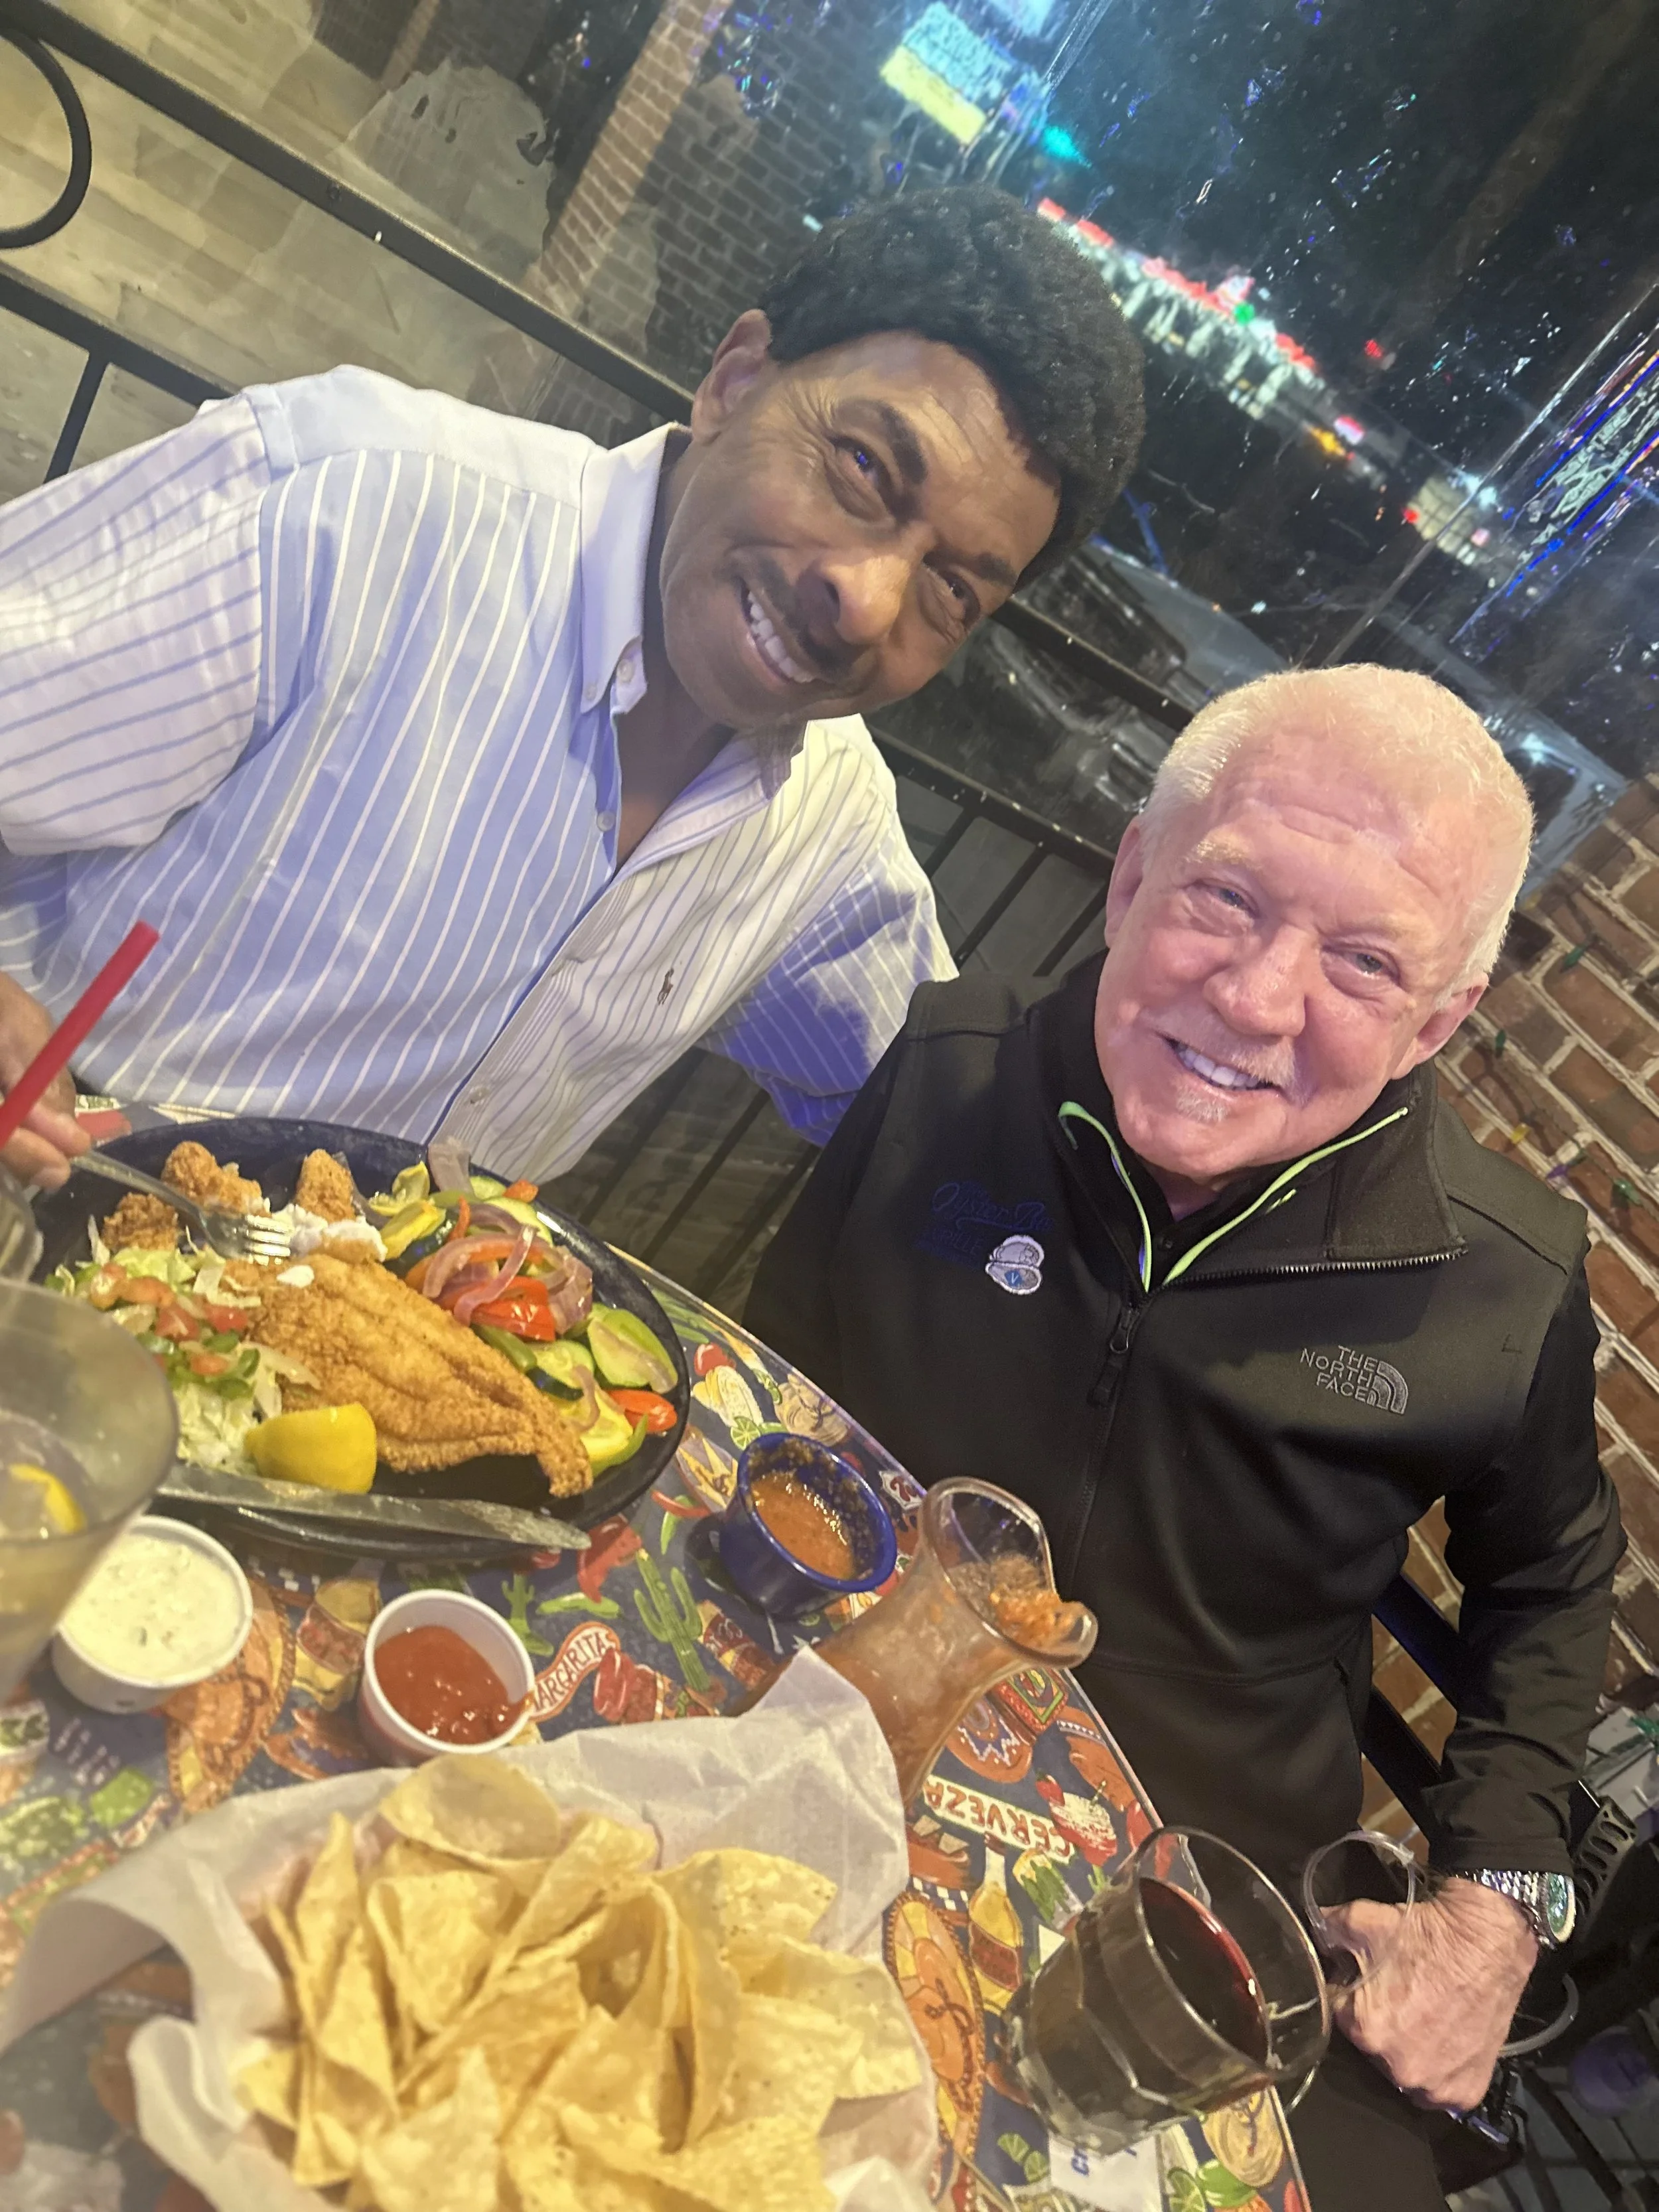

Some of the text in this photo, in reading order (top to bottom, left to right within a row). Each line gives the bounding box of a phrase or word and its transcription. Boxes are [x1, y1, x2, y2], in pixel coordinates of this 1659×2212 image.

[1300, 1348, 1373, 1388] NORTH
[1338, 1345, 1378, 1372] THE
[1316, 1372, 1368, 1403] FACE
